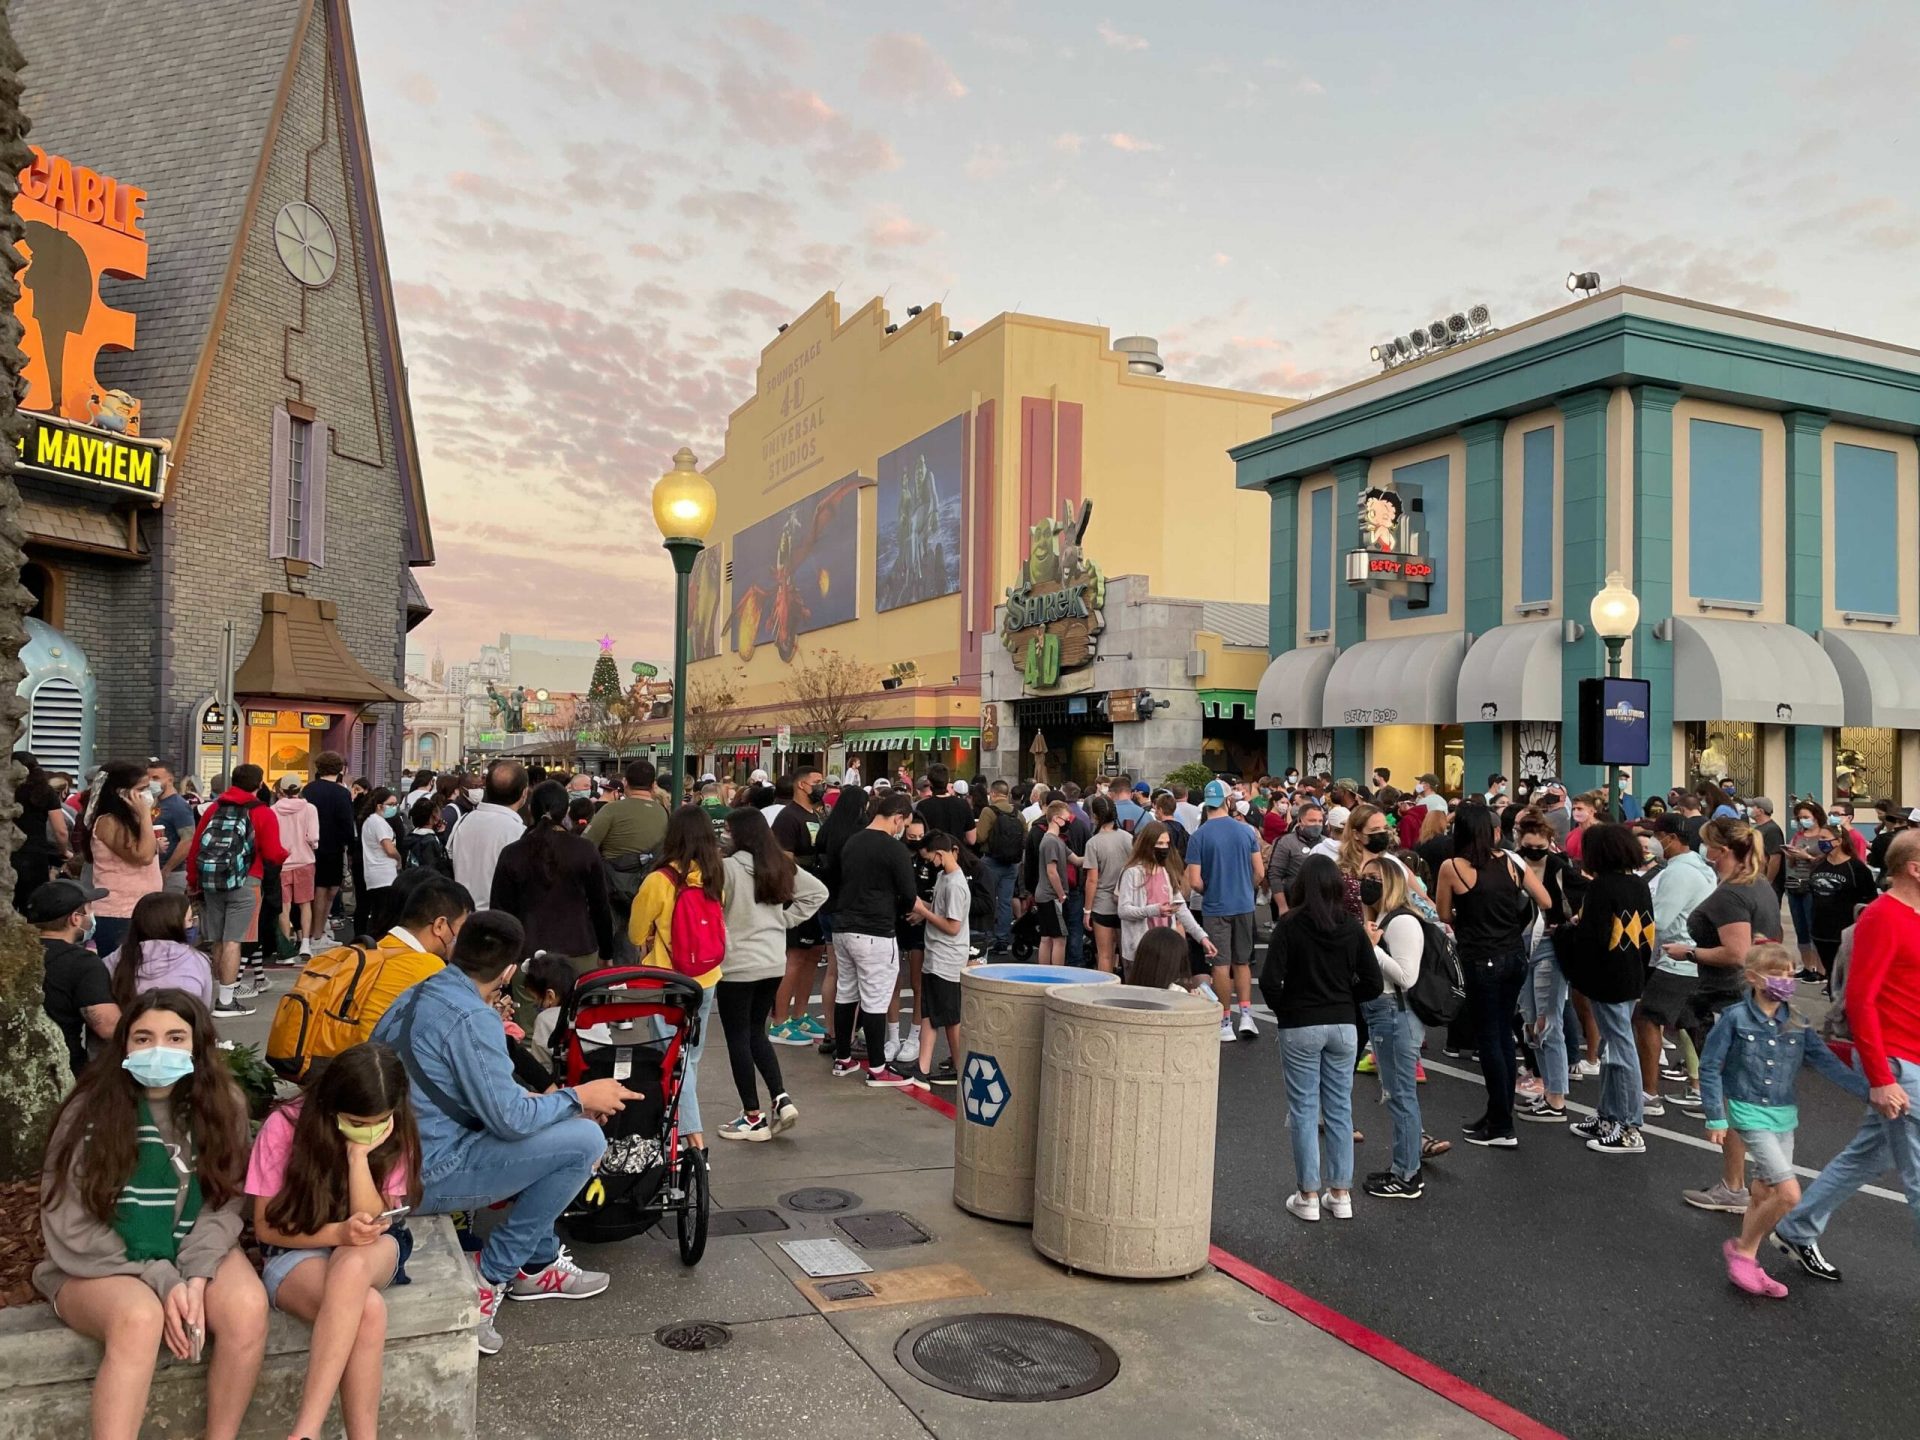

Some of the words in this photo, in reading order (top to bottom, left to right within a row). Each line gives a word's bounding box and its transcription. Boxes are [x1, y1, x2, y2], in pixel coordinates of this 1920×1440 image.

[766, 339, 821, 395] SOUNDSTAGE
[762, 407, 824, 461] UNIVERSAL
[37, 426, 152, 488] MAYHEM
[769, 437, 817, 481] STUDIOS
[1370, 560, 1401, 573] BETTY
[1404, 563, 1432, 576] BOOP
[1344, 708, 1371, 724] BETTY
[1373, 708, 1398, 723] BOOP
[536, 1268, 569, 1294] AX
